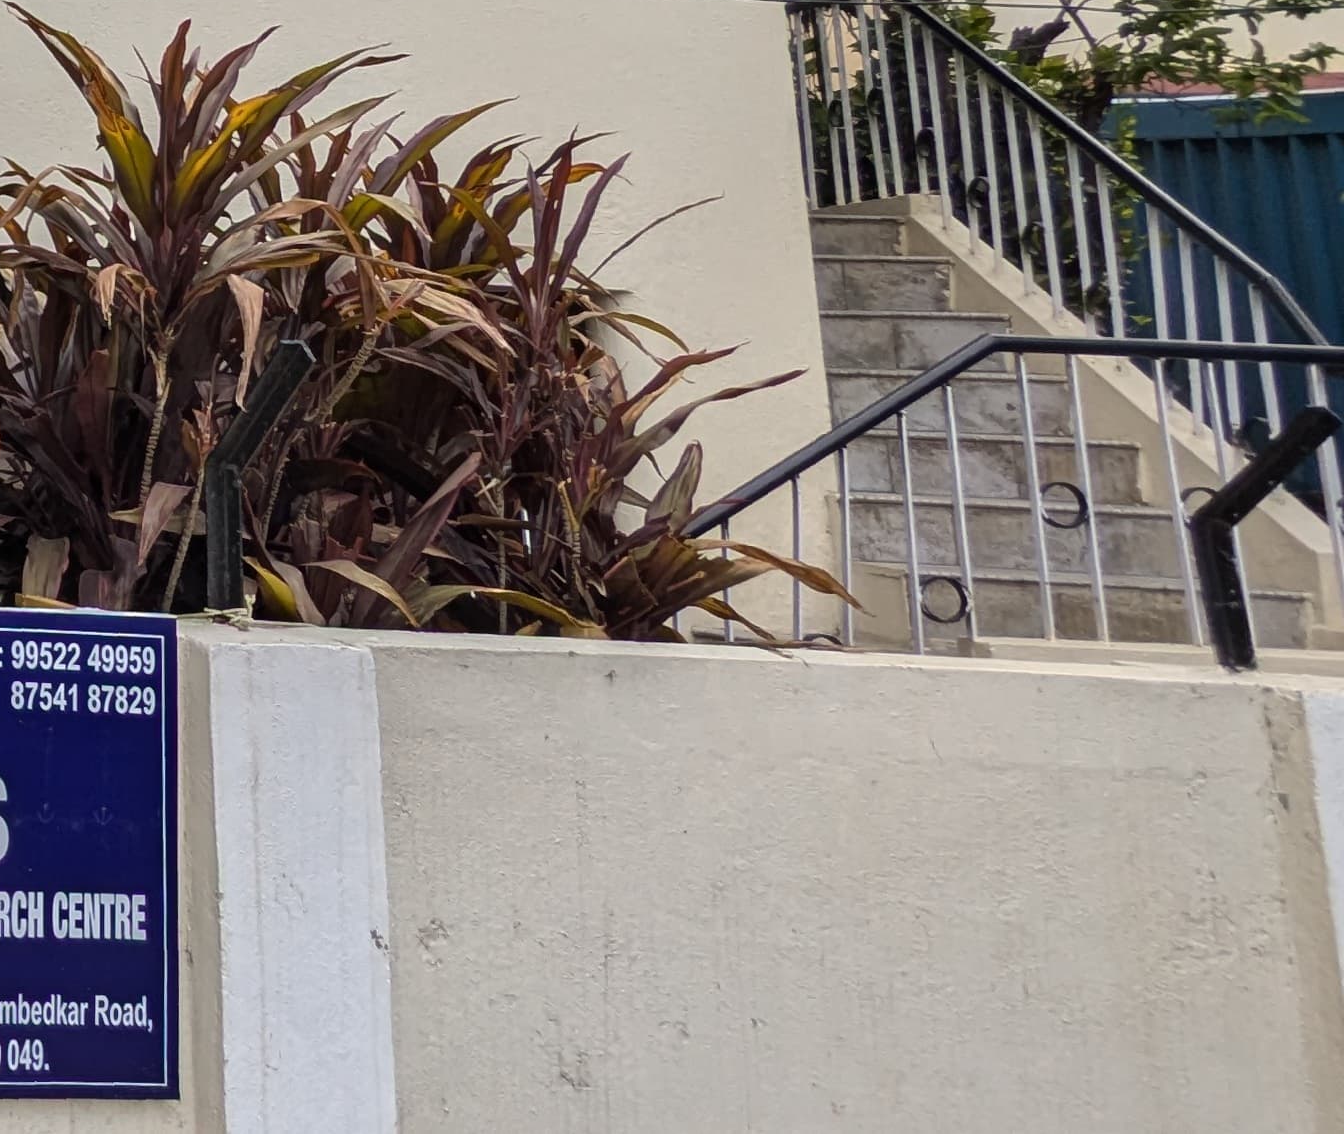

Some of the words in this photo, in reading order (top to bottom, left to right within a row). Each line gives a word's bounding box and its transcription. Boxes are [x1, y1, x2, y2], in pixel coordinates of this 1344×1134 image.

[11, 639, 81, 671] 99522
[87, 643, 156, 675] 49959
[10, 680, 78, 712] 87541
[87, 684, 156, 716] 87829
[52, 892, 147, 941] CENTRE
[94, 994, 153, 1033] Road,
[7, 1039, 50, 1072] 049.
